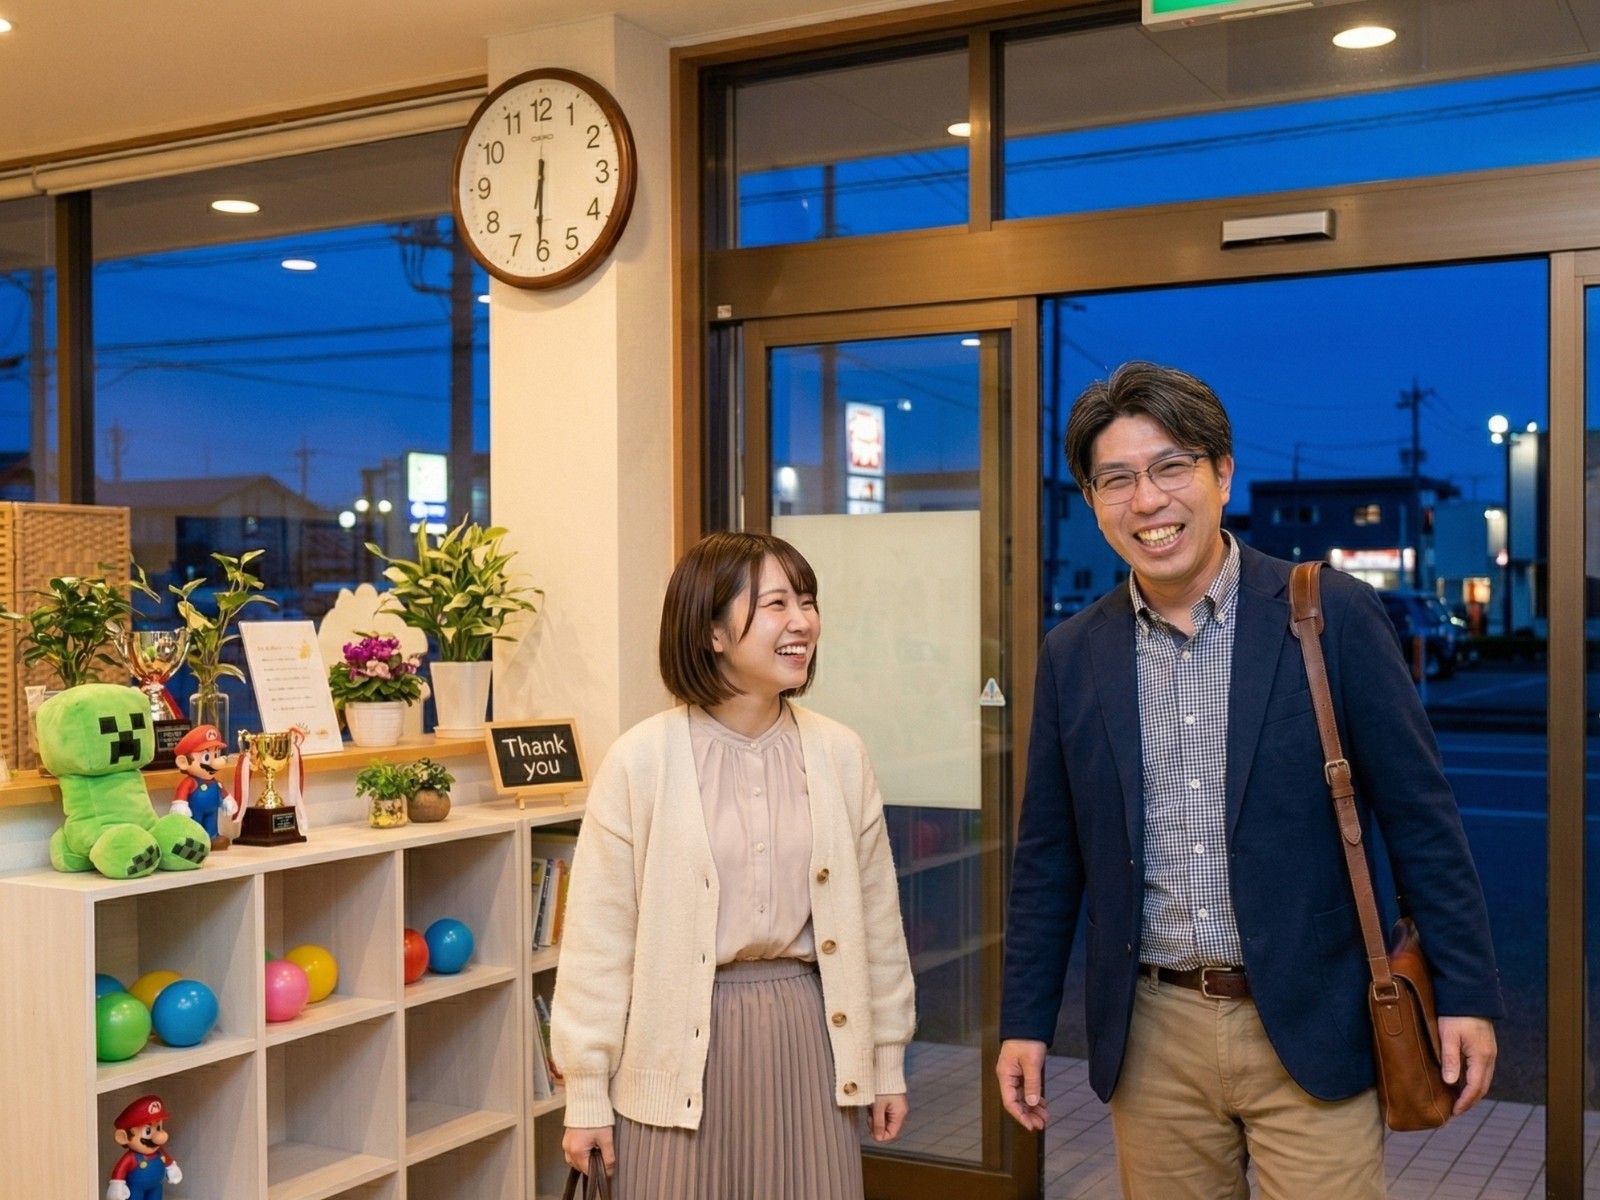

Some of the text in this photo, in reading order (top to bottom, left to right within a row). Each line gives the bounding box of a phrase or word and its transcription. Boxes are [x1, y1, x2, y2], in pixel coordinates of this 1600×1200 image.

[529, 97, 553, 122] 12
[566, 102, 574, 126] 1
[503, 111, 521, 136] 11
[586, 124, 600, 149] 2
[483, 140, 505, 165] 10
[595, 159, 609, 184] 3
[477, 177, 491, 200] 9
[586, 197, 601, 220] 4
[486, 210, 500, 234] 8
[509, 233, 522, 257] 7
[536, 239, 550, 262] 6
[565, 226, 579, 251] 5
[501, 733, 568, 758] Thank
[523, 759, 561, 782] you
[150, 1102, 160, 1113] M
